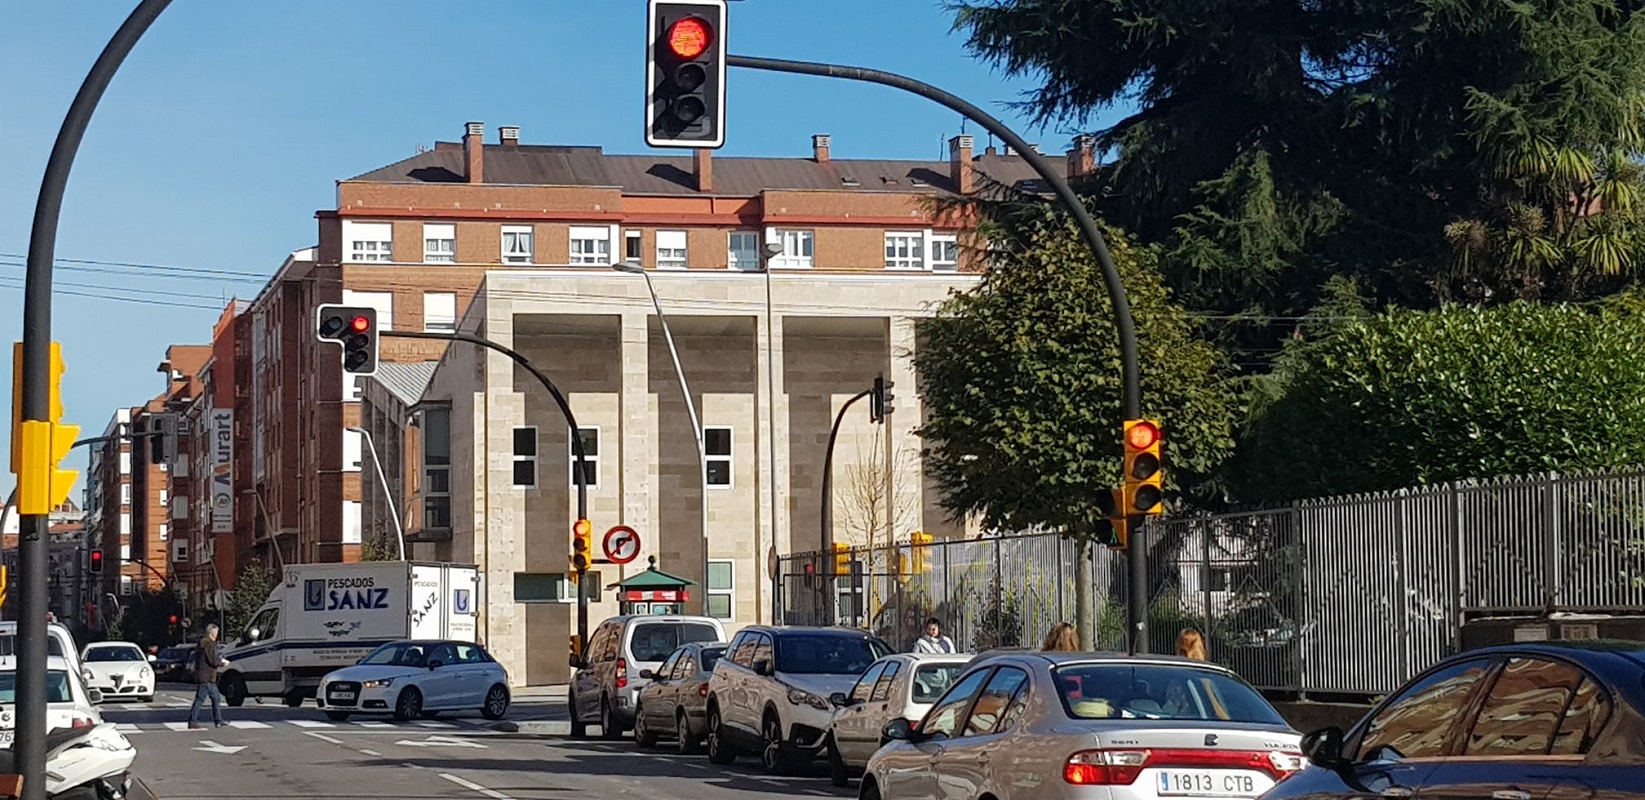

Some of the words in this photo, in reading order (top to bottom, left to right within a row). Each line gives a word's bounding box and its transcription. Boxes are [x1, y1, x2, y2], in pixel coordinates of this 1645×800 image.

[215, 414, 230, 486] Aurart
[328, 577, 375, 589] PESCADOS
[328, 588, 389, 610] SANZ
[413, 591, 438, 628] SANZ
[1173, 774, 1212, 791] 1813
[1224, 775, 1254, 792] CTB
